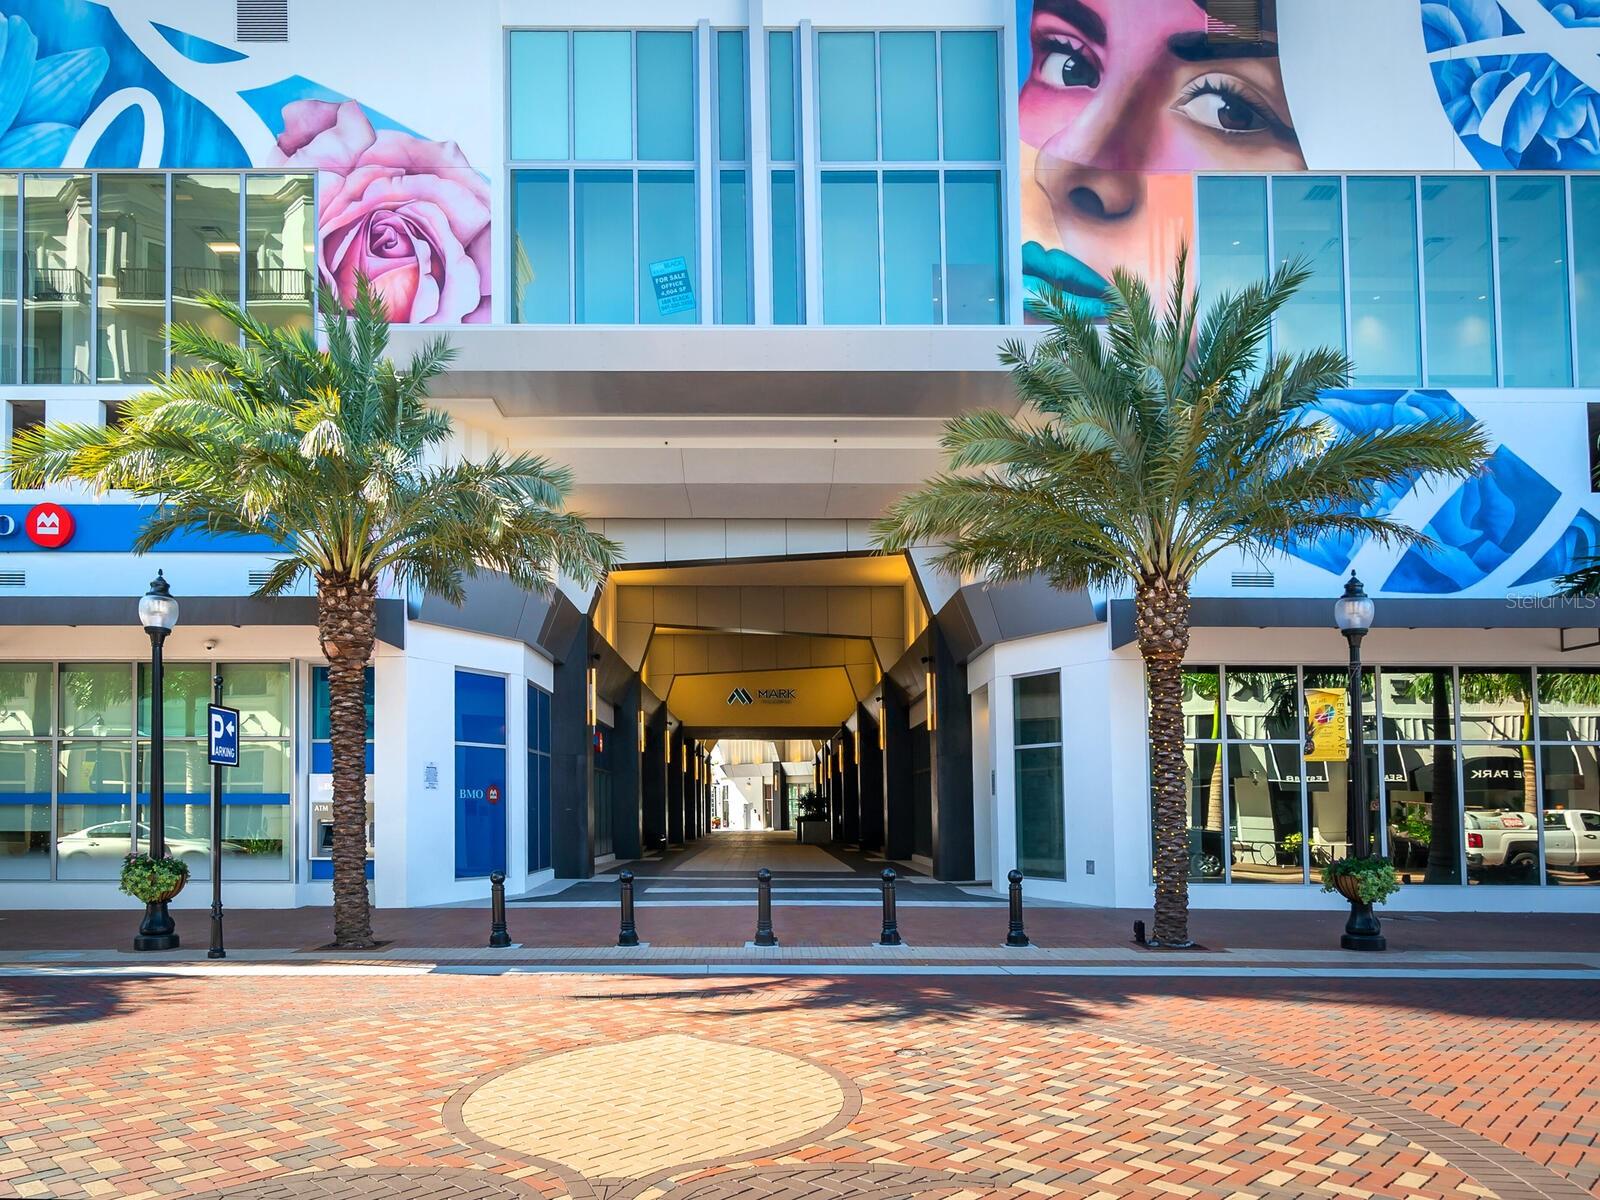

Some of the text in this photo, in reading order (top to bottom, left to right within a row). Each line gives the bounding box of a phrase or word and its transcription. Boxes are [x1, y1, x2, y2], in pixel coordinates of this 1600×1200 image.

[655, 272, 686, 284] FOR SALE
[661, 281, 684, 289] OFFICE
[758, 688, 797, 699] MARK
[1336, 697, 1346, 755] LEMON AVE
[459, 789, 484, 799] BMO
[314, 804, 329, 812] ATM
